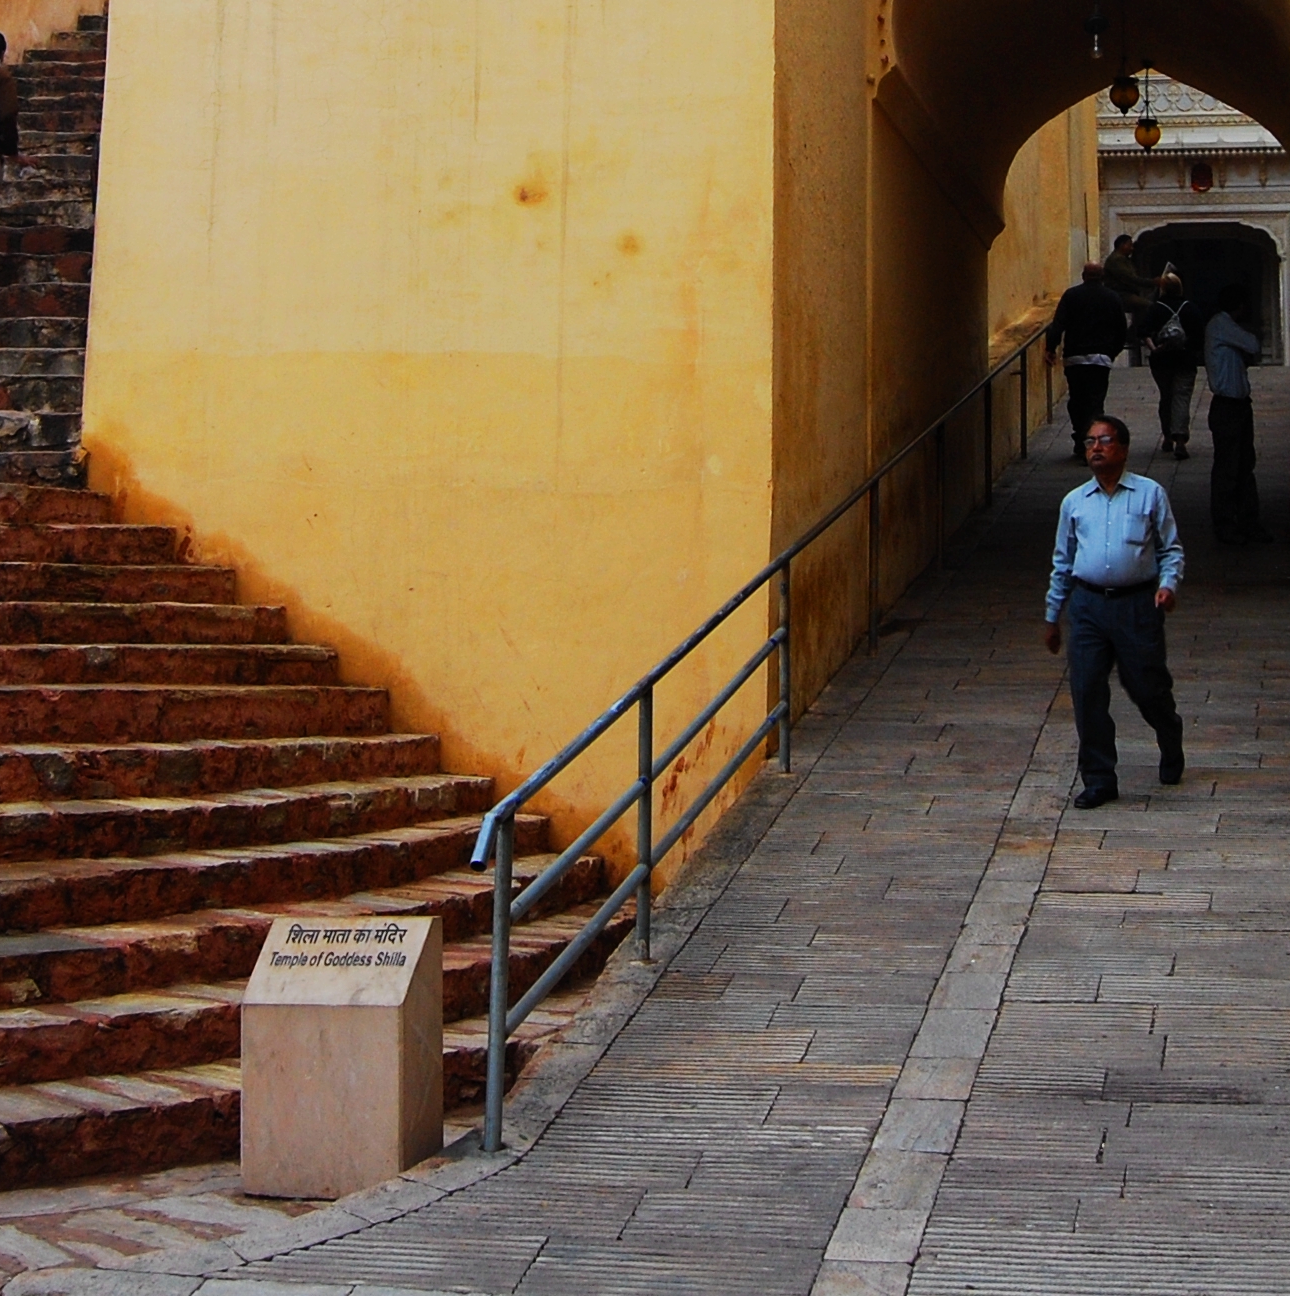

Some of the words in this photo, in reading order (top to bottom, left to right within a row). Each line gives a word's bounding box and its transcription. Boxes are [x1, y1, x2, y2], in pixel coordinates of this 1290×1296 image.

[286, 924, 321, 944] शिला
[323, 930, 352, 943] माता
[354, 929, 372, 943] का
[374, 923, 408, 944] मंदिर
[270, 952, 308, 969] Temple
[309, 952, 324, 966] of
[324, 952, 372, 966] Goddess
